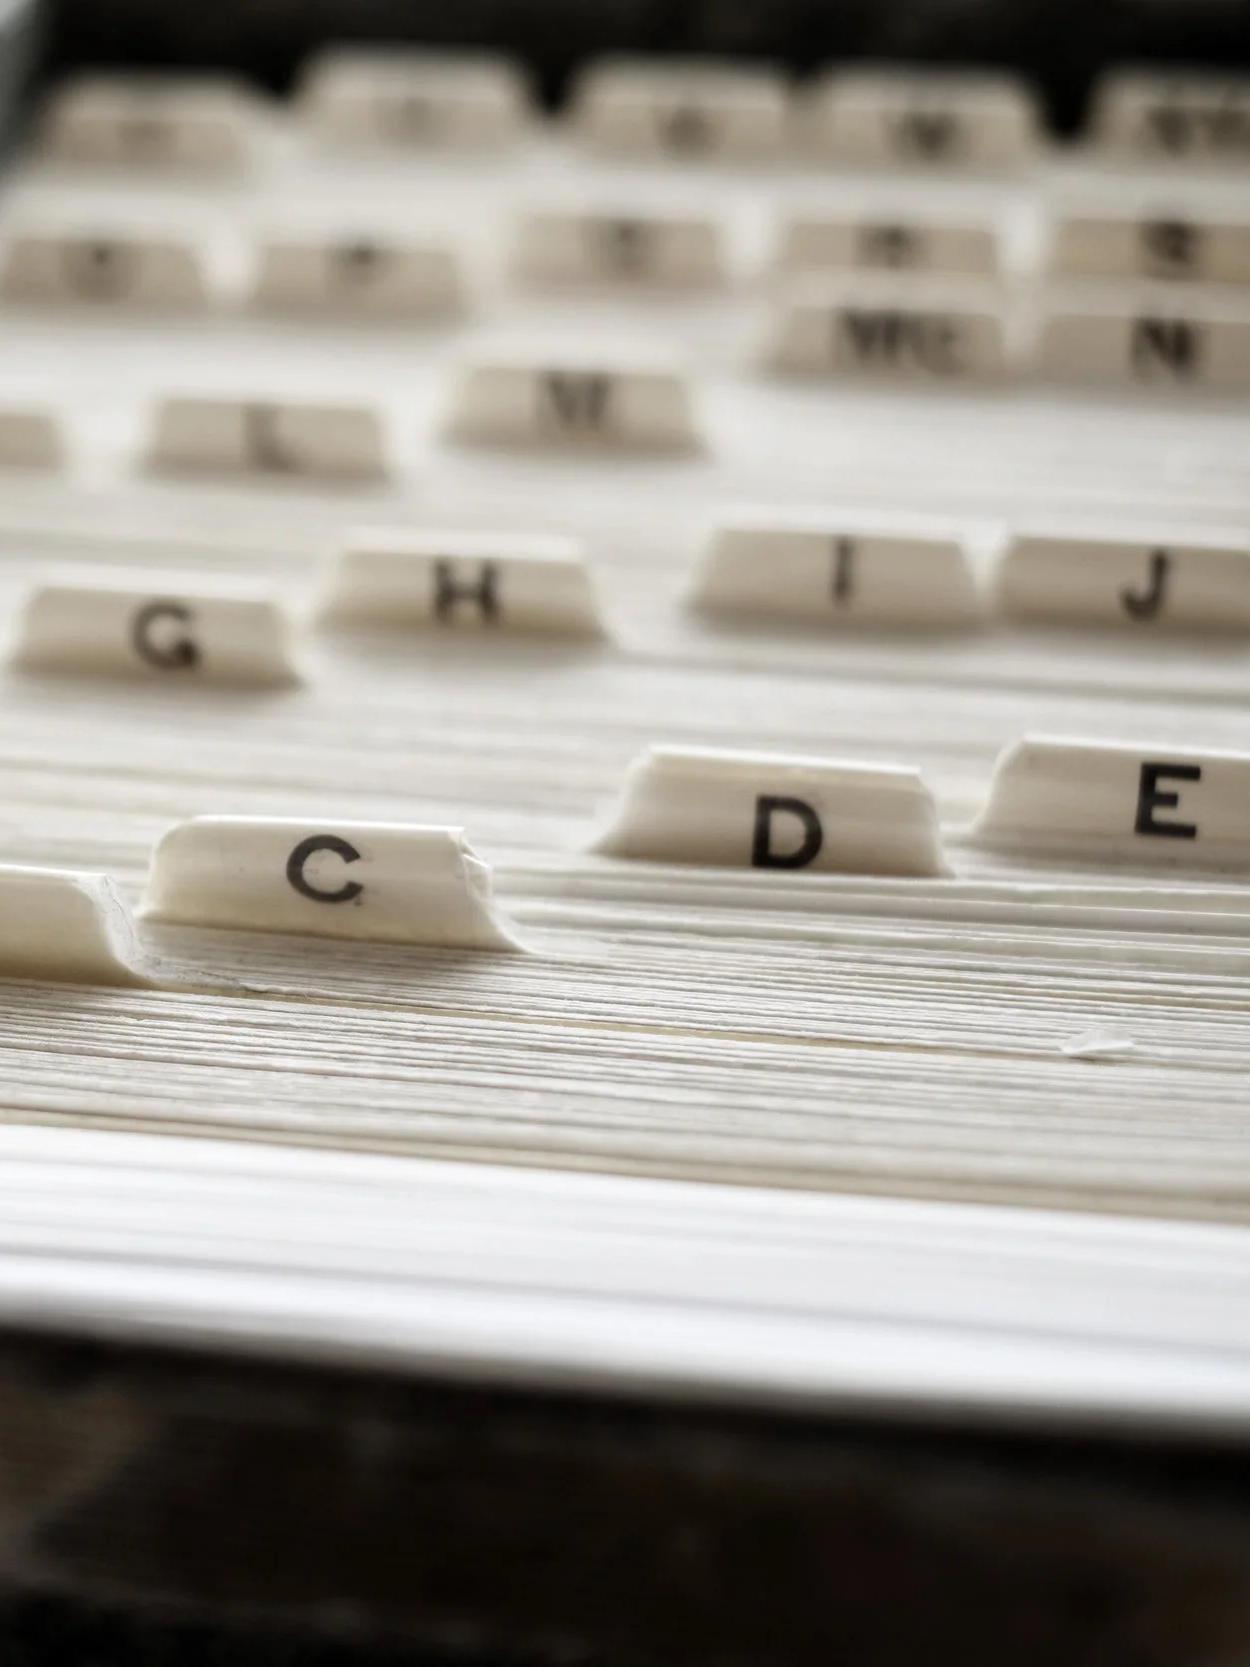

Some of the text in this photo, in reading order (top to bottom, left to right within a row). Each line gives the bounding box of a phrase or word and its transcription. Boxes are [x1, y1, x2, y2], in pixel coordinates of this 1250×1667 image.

[1128, 314, 1200, 384] N
[244, 402, 305, 476] L
[434, 557, 500, 628] H
[830, 534, 856, 604] I
[1117, 546, 1171, 624] J
[129, 599, 199, 670] G
[751, 794, 823, 869] D
[1134, 762, 1202, 840] E
[285, 834, 365, 904] C
